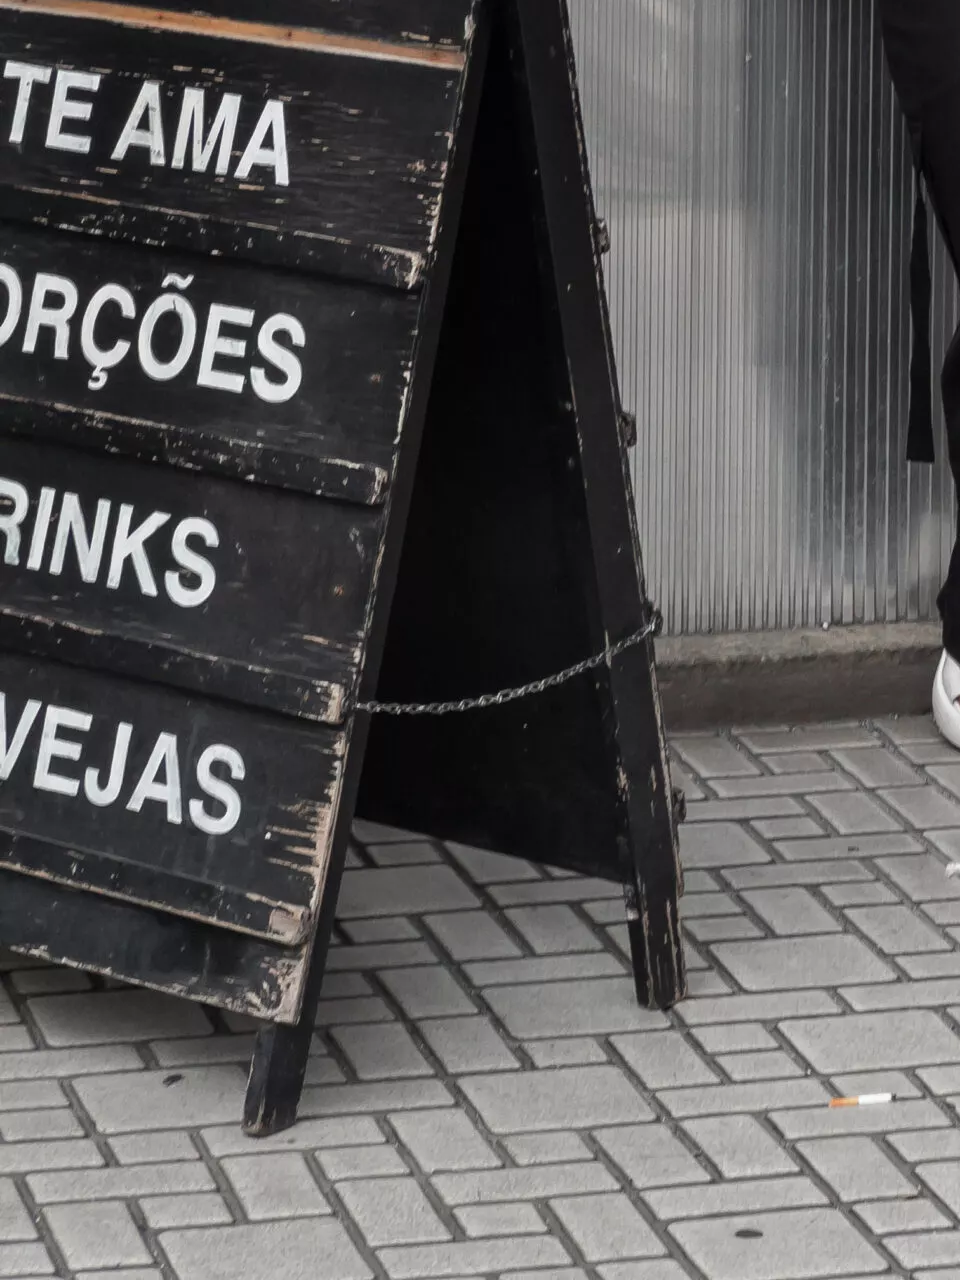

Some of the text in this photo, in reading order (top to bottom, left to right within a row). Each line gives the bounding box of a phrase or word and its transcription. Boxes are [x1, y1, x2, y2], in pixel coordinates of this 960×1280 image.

[3, 60, 290, 187] TE AMA
[0, 691, 246, 835] VEJAS
